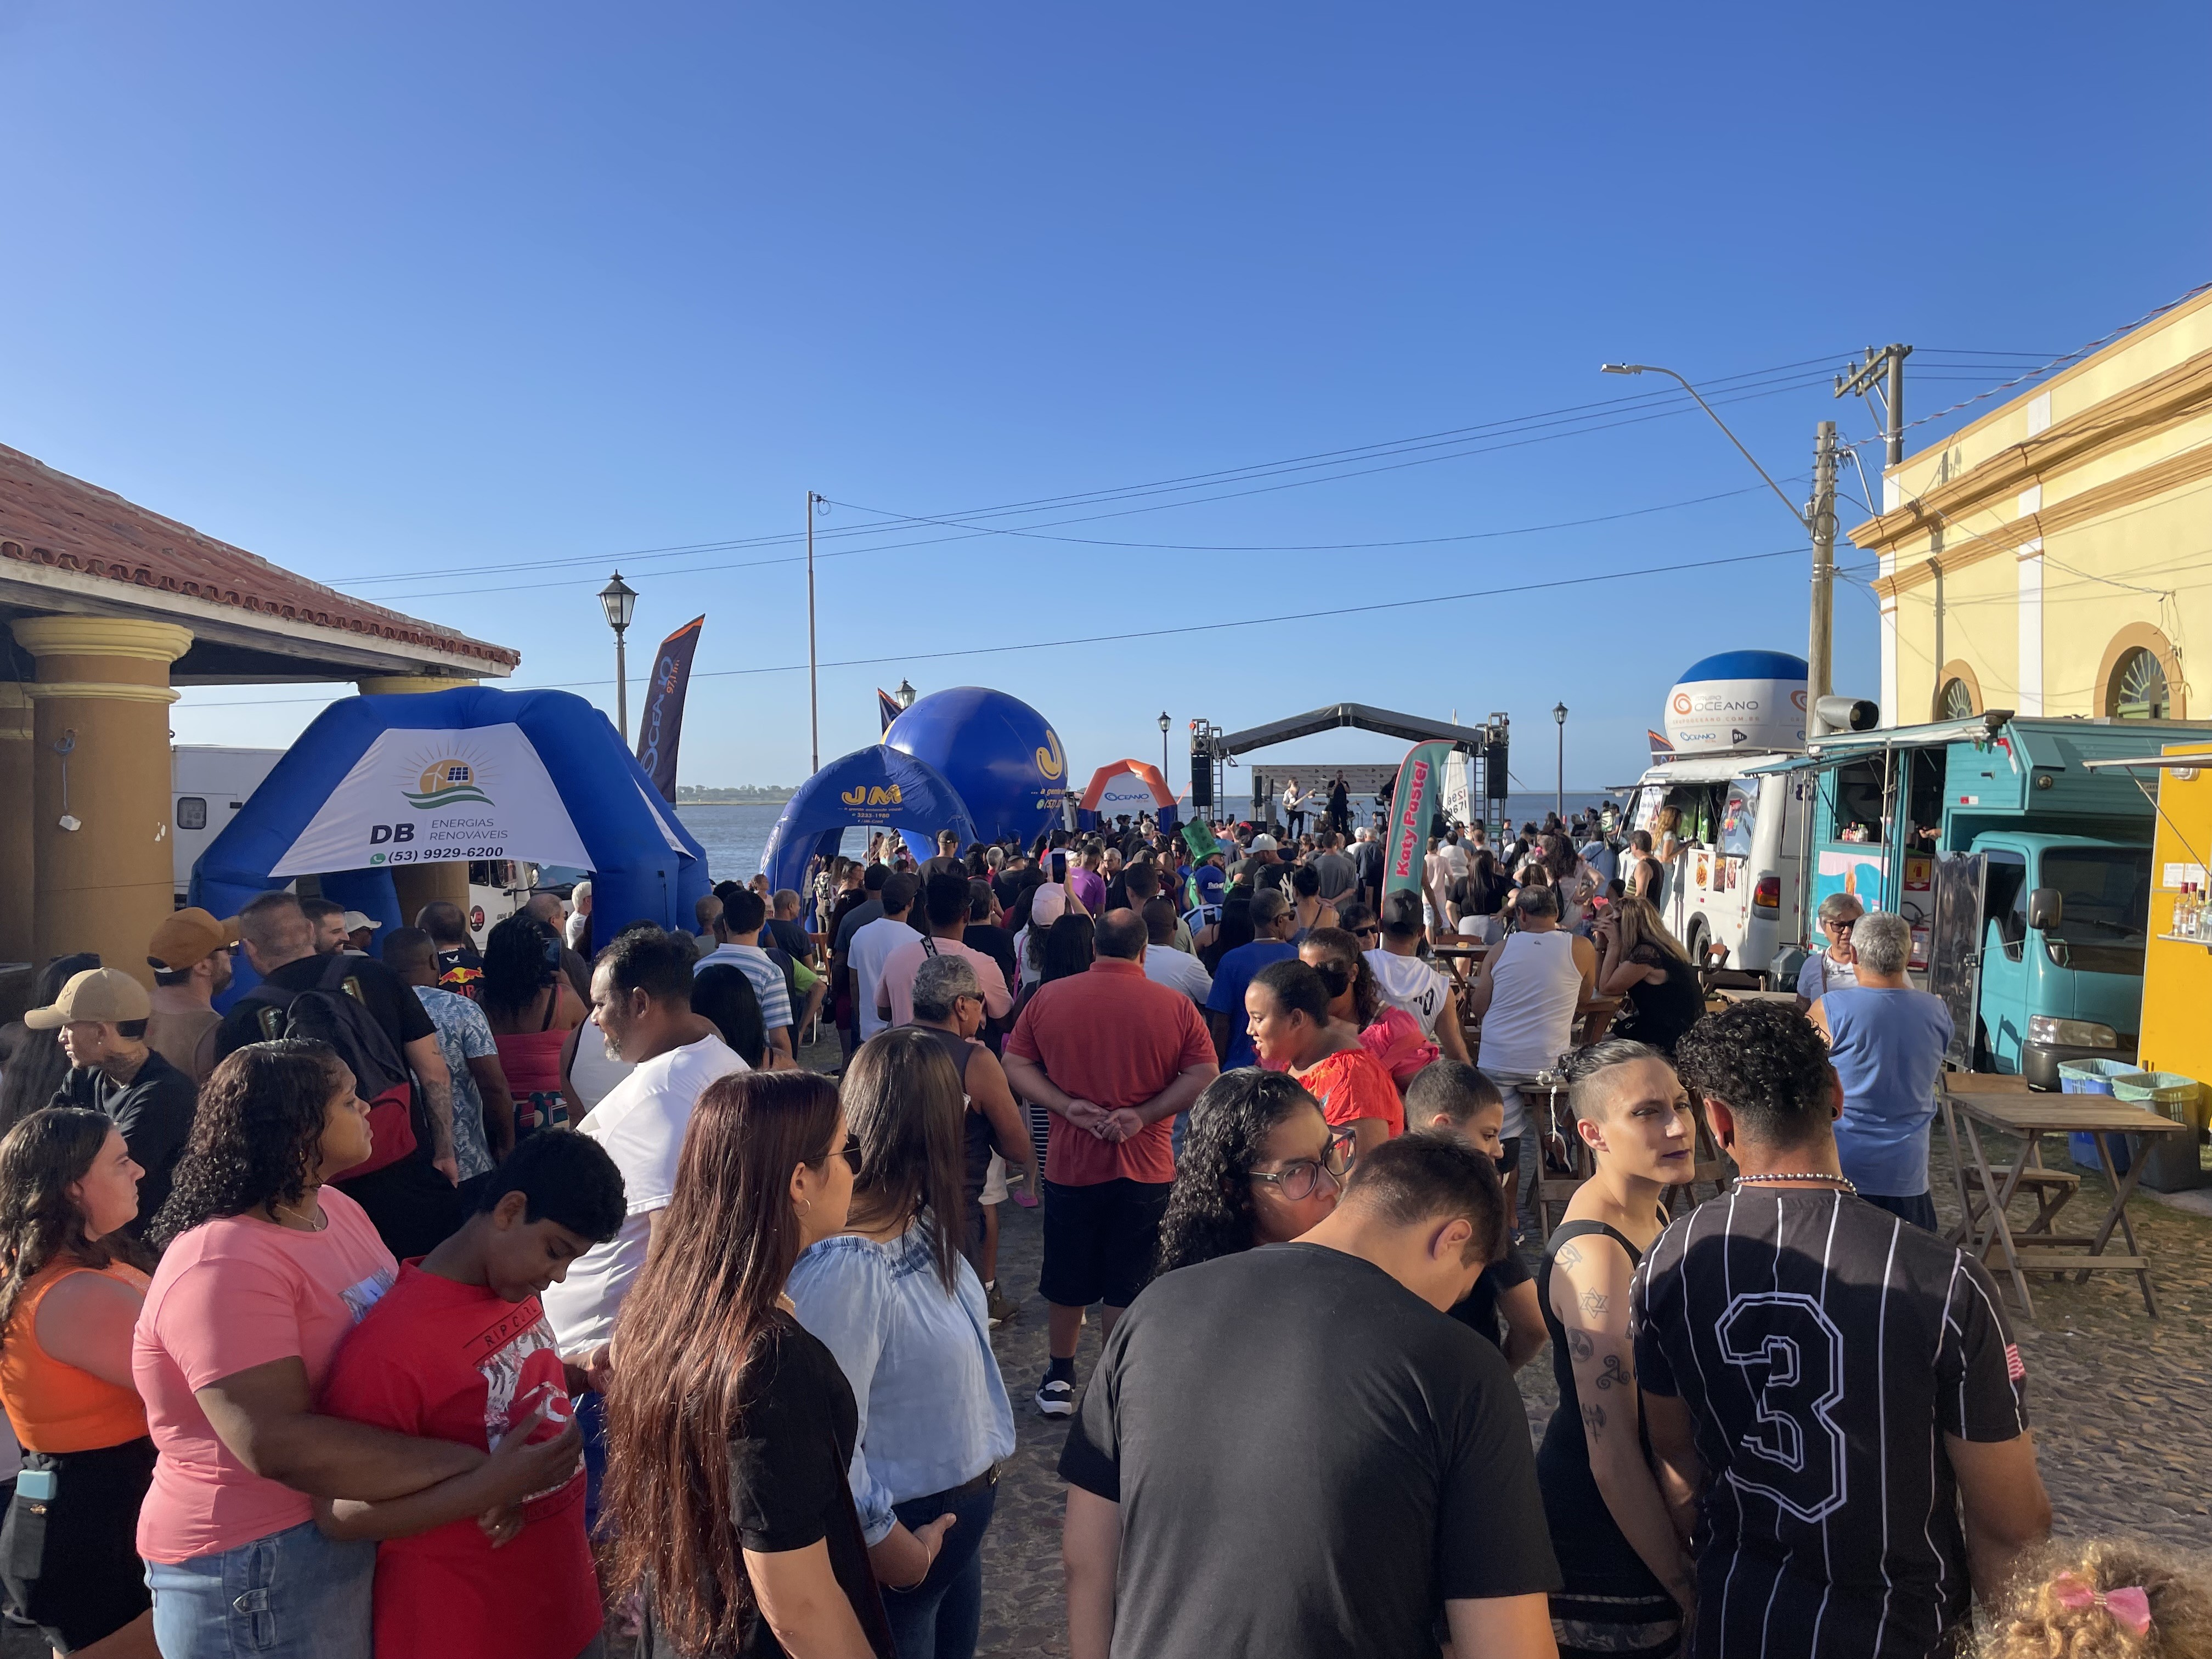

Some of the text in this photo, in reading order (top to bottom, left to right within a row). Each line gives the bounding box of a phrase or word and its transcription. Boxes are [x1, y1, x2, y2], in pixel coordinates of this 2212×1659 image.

[1694, 701, 1758, 712] OCEANO
[1036, 729, 1068, 780] J
[842, 784, 902, 805] JM
[1104, 793, 1149, 801] OCEANO
[1403, 759, 1429, 827] Pastel
[370, 819, 494, 844] DB ENERGIAS
[430, 830, 508, 840] RENOVÁVEIS
[388, 847, 503, 863] (53) 9929-6200
[1395, 827, 1418, 877] Katy
[484, 1324, 506, 1347] RIP
[1714, 1292, 1847, 1523] 3
